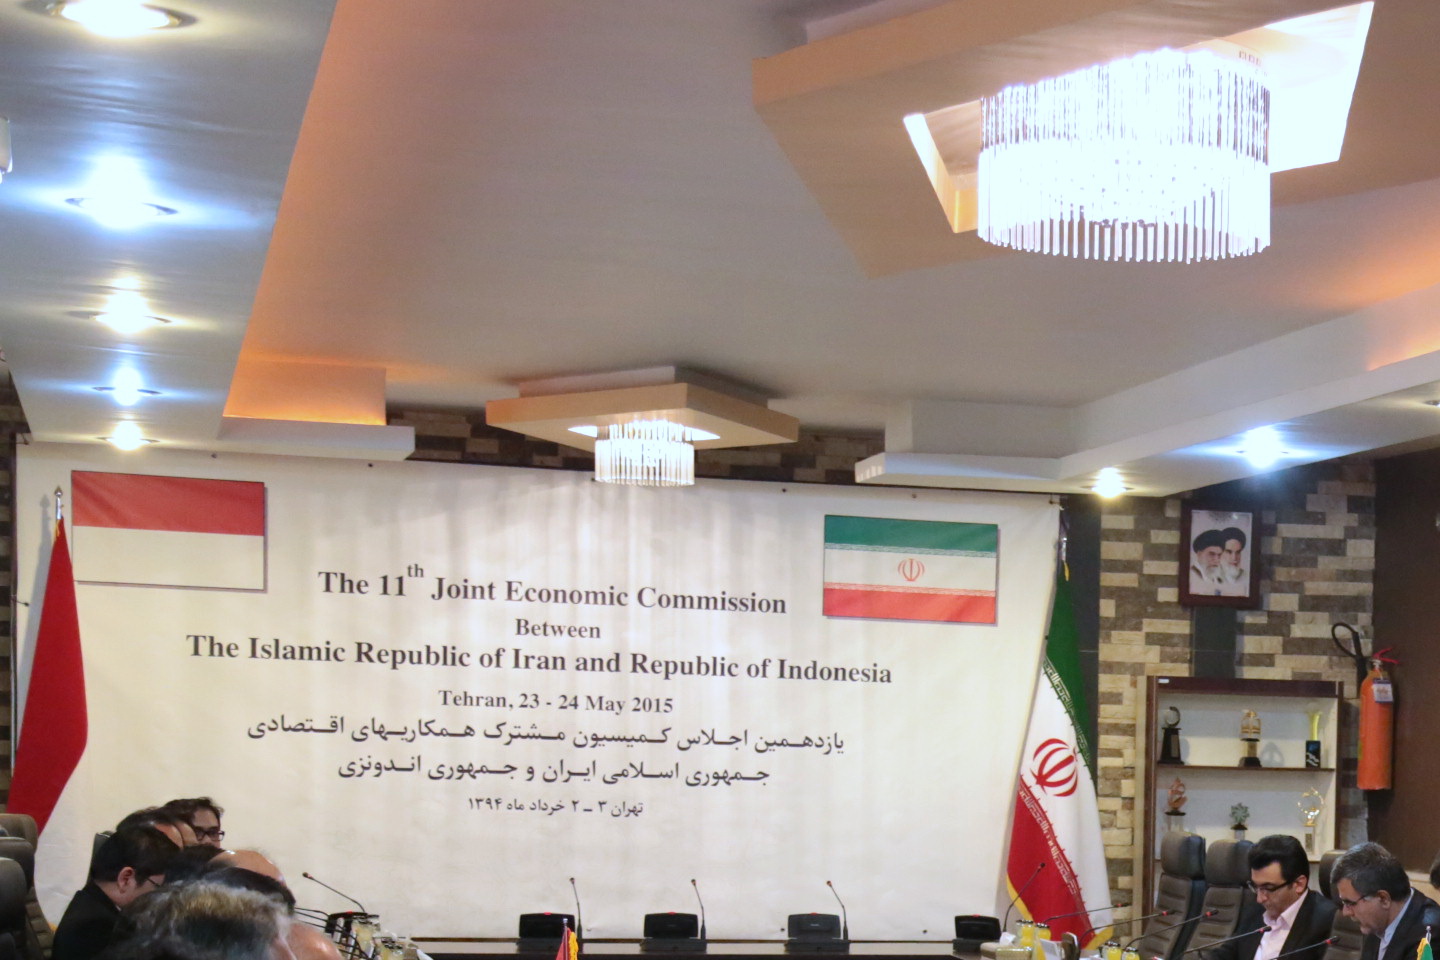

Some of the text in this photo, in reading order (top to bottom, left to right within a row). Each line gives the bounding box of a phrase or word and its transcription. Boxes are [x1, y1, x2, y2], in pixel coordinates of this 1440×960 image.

[317, 570, 369, 596] The
[430, 576, 497, 602] Joint
[505, 580, 629, 608] Economic
[636, 586, 788, 615] Commission
[514, 618, 602, 640] Between
[185, 634, 893, 685] The Islamic Republic of Iran and Republic of Indonesia
[437, 689, 515, 711] Tehran,
[518, 692, 540, 709] 23
[558, 694, 580, 711] 24
[585, 695, 626, 716] May
[631, 696, 674, 714] 2015
[247, 713, 346, 740] اقتصادی
[483, 720, 567, 748] مشترک
[572, 725, 673, 750] کمیسیون
[676, 727, 749, 752] اجلاس
[754, 731, 845, 756] یازدهمین
[337, 753, 772, 788] جمهوری اسلامی ایران و جمهوری اندونزی
[468, 797, 503, 811] ۱۳۹۴
[506, 798, 526, 811] ماه
[529, 797, 567, 817] خرداد
[610, 799, 645, 819] تهران
